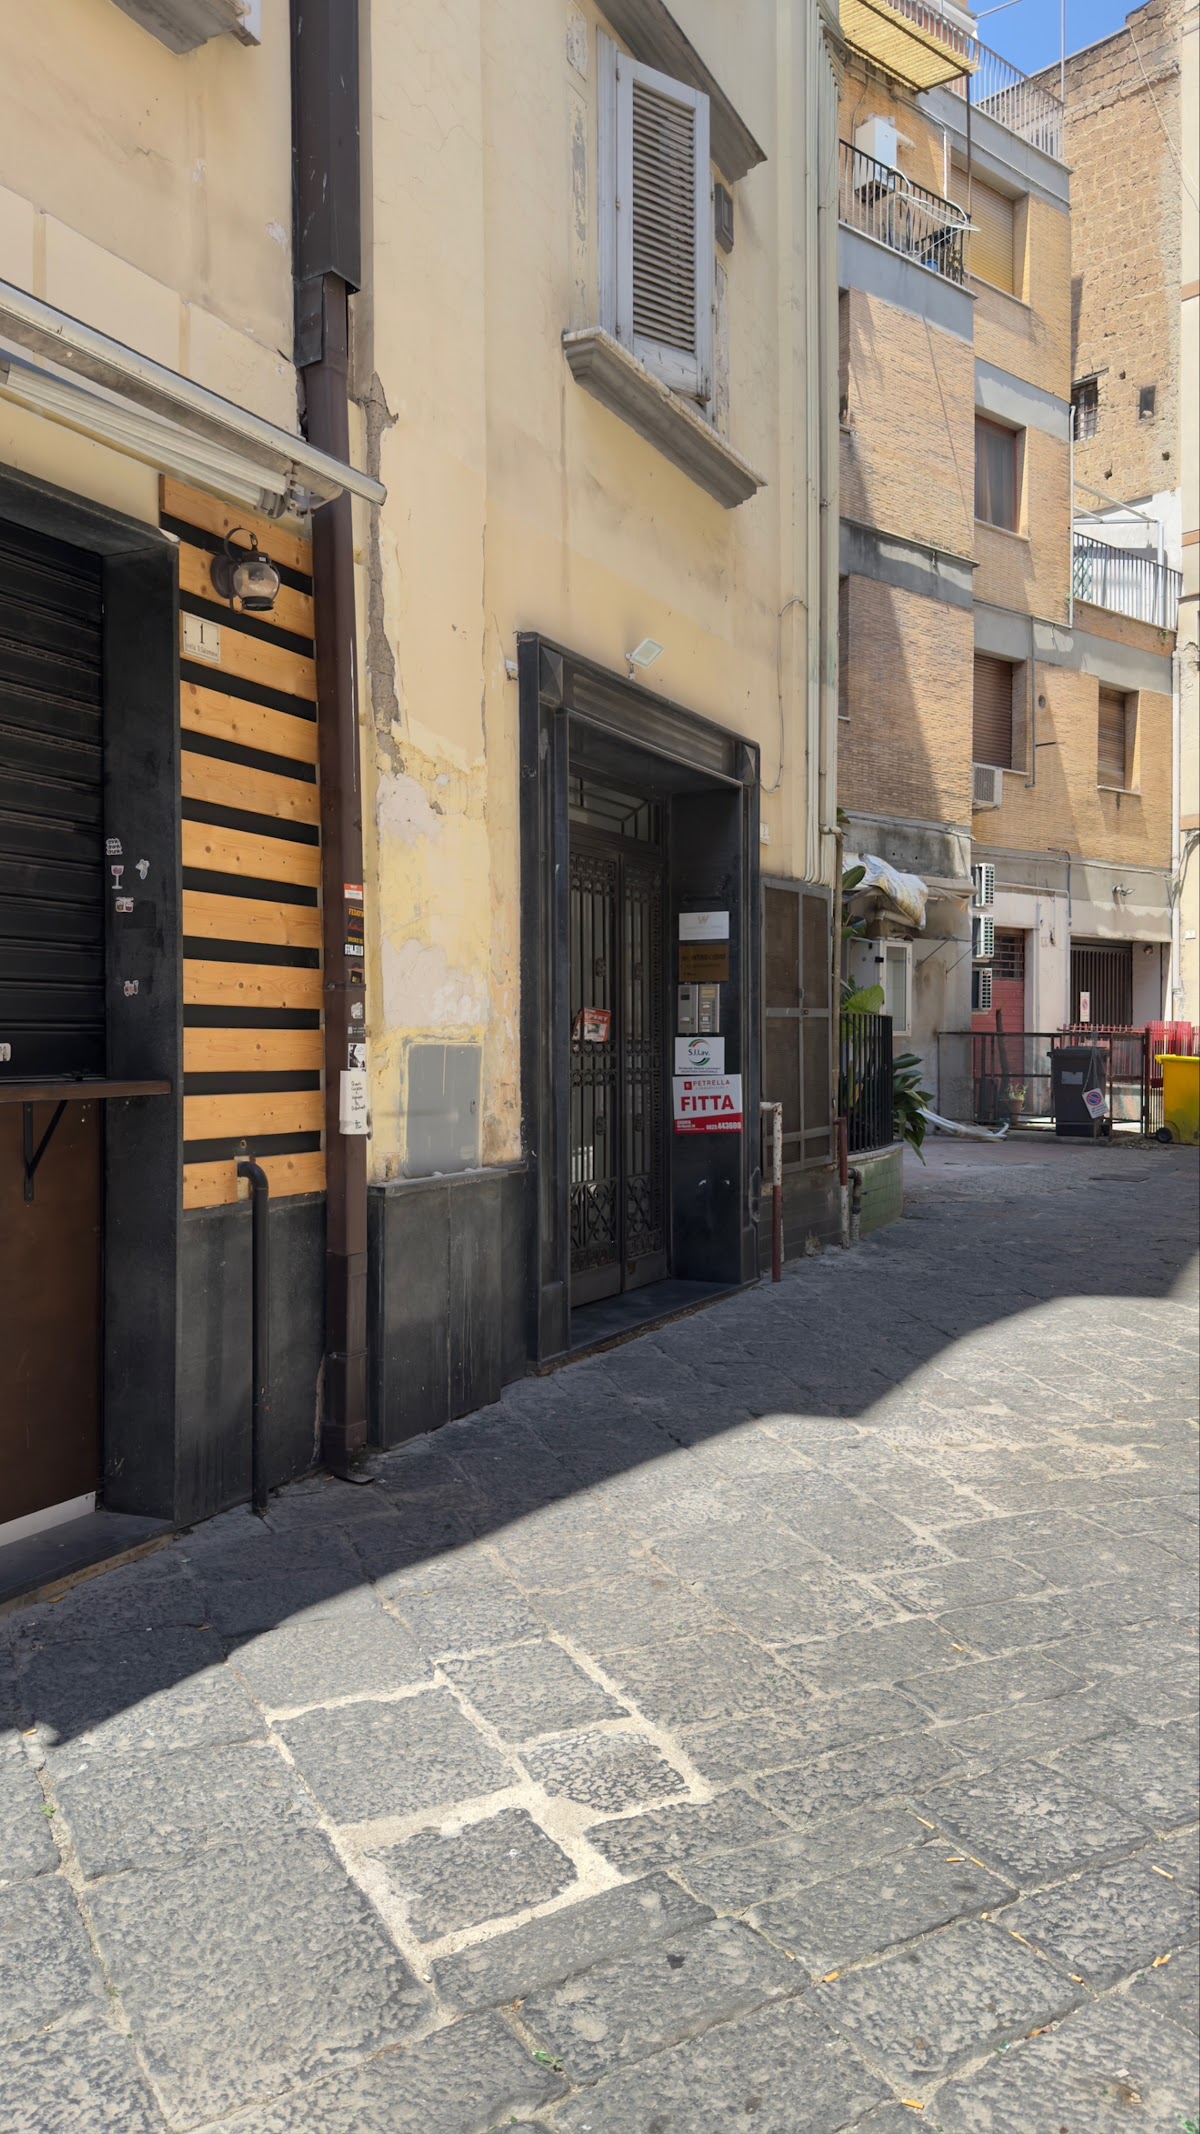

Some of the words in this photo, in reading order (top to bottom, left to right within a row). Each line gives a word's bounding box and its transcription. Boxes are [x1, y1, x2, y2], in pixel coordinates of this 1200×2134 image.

[199, 623, 205, 645] 1
[693, 1079, 730, 1087] PETRELLA
[681, 1095, 734, 1112] FITTA
